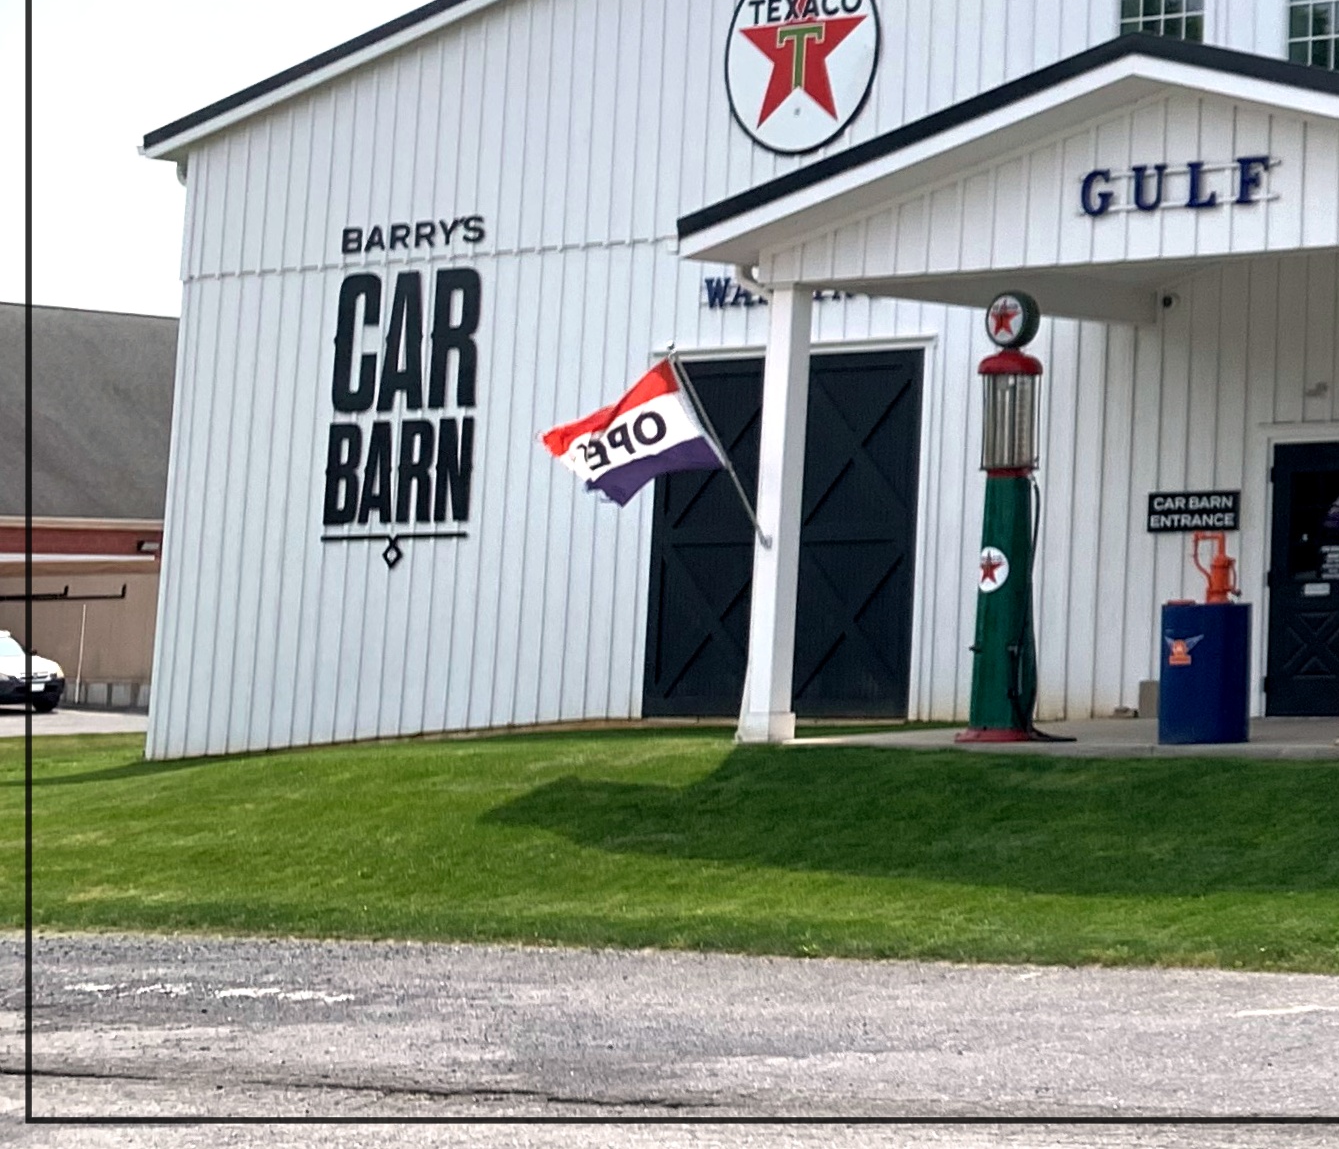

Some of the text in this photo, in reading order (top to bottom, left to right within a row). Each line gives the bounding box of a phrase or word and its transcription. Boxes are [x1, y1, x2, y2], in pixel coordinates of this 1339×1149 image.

[1080, 154, 1276, 220] GULF
[341, 216, 486, 255] BARRY'S
[331, 267, 483, 415] CAR
[322, 416, 476, 528] BARN
[1150, 512, 1235, 529] ENTRANCE
[1153, 495, 1234, 511] CAR BARN
